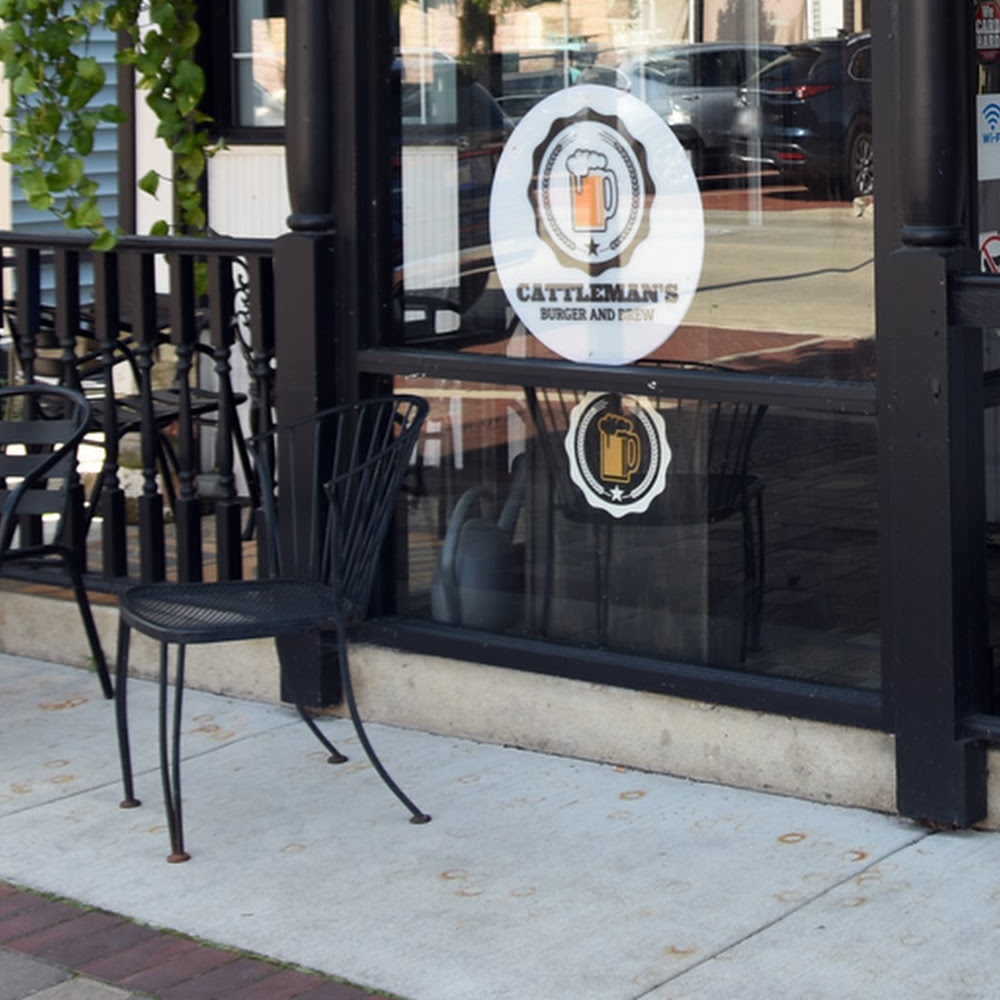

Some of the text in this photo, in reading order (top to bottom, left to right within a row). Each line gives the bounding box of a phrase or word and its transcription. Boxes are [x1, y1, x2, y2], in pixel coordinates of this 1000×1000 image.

[516, 283, 679, 303] CATTLEMAN'S
[540, 307, 655, 321] BURGER AND BREW
